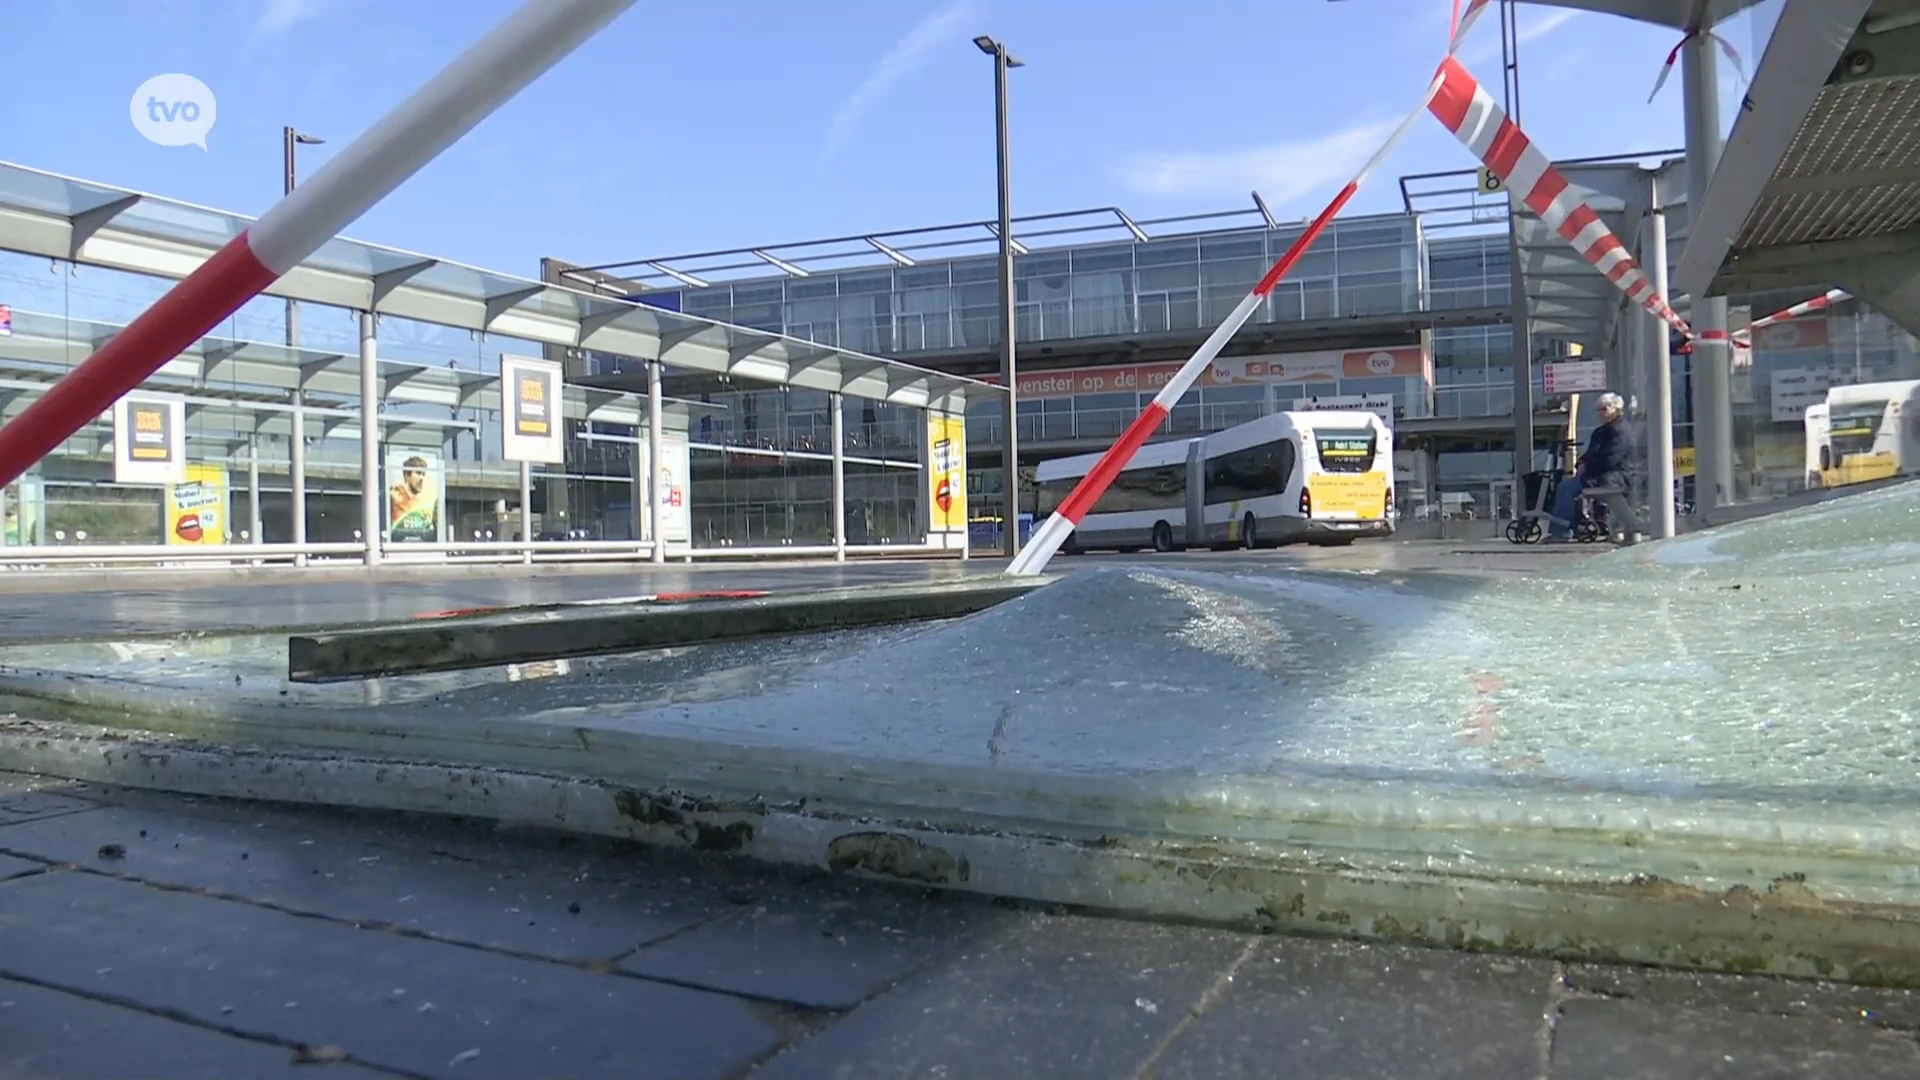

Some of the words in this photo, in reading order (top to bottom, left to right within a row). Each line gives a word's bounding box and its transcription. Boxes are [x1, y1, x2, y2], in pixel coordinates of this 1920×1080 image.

[1486, 169, 1500, 190] 8
[1372, 358, 1390, 368] tvo
[1215, 368, 1231, 377] tvo
[1016, 375, 1073, 394] venster
[1082, 375, 1104, 392] op
[1114, 371, 1136, 388] de
